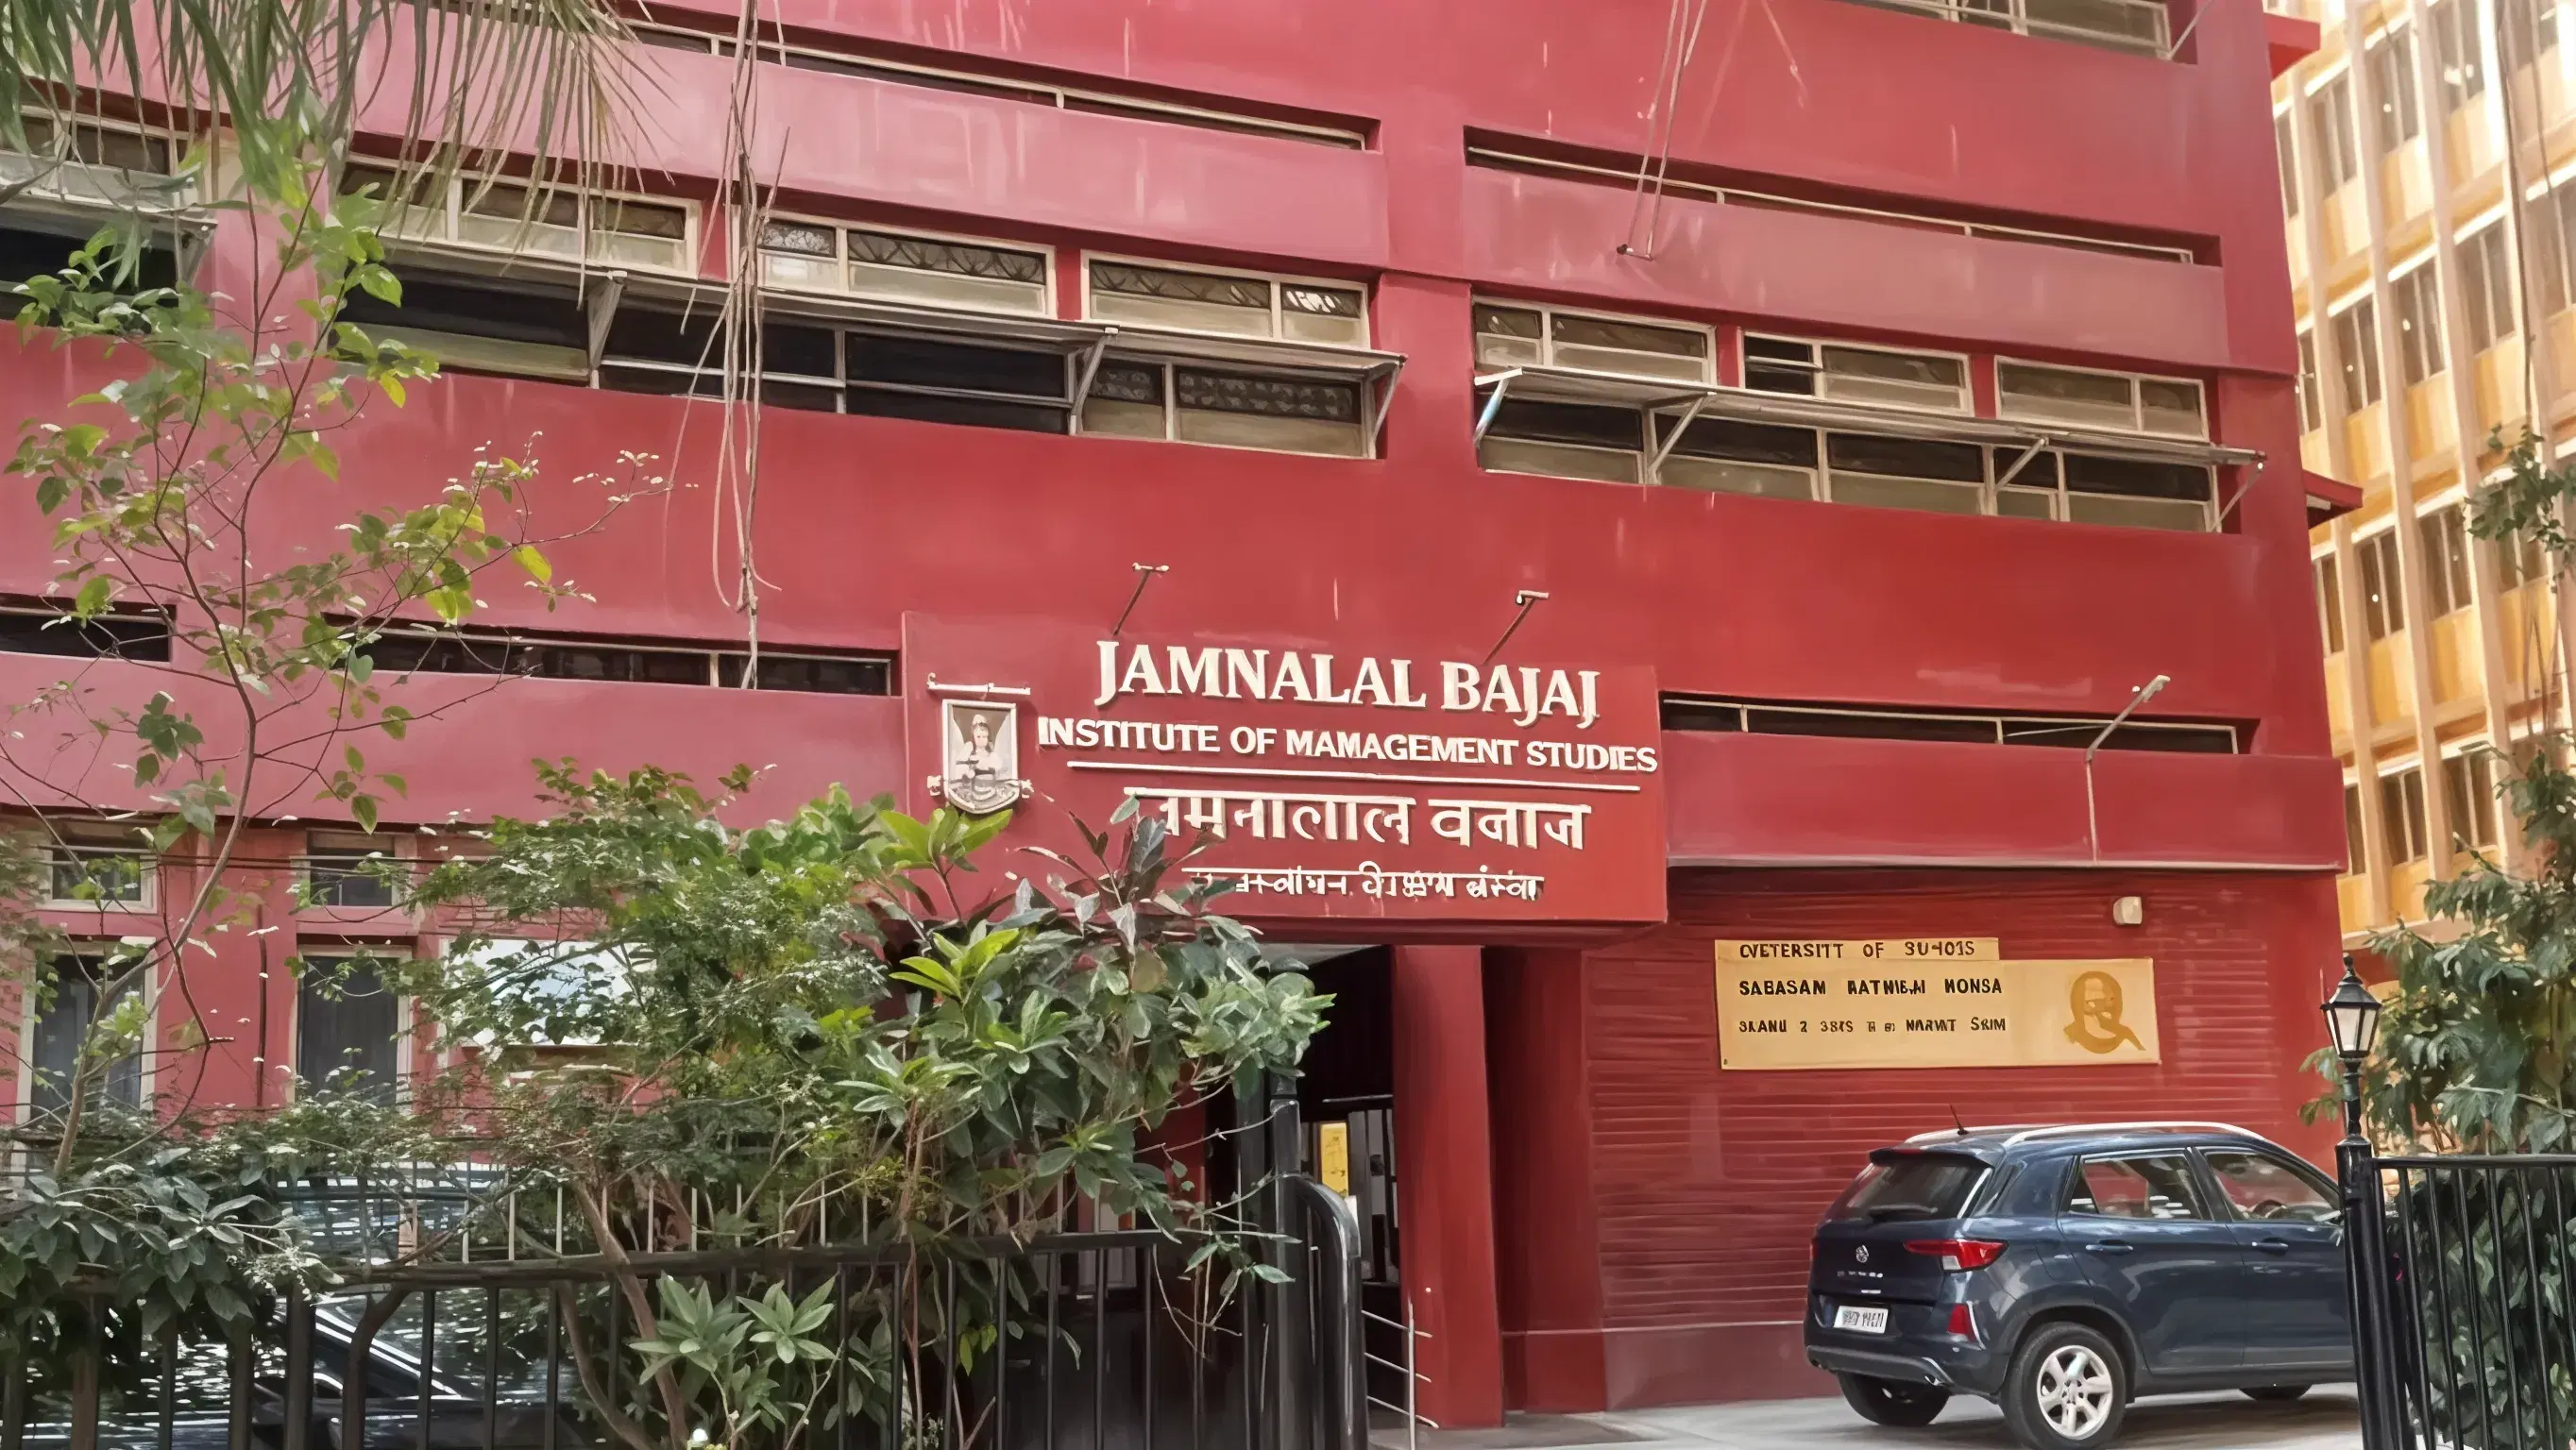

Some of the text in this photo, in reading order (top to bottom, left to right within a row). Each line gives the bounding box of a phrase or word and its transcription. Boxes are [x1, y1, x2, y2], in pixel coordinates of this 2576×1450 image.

[1094, 640, 1601, 729] JAMNALAL BAJAJ
[1037, 717, 1220, 752] INSTITUTE
[1230, 726, 1277, 754] OF
[1526, 740, 1658, 772] STUDIES
[1862, 942, 1885, 958] OF
